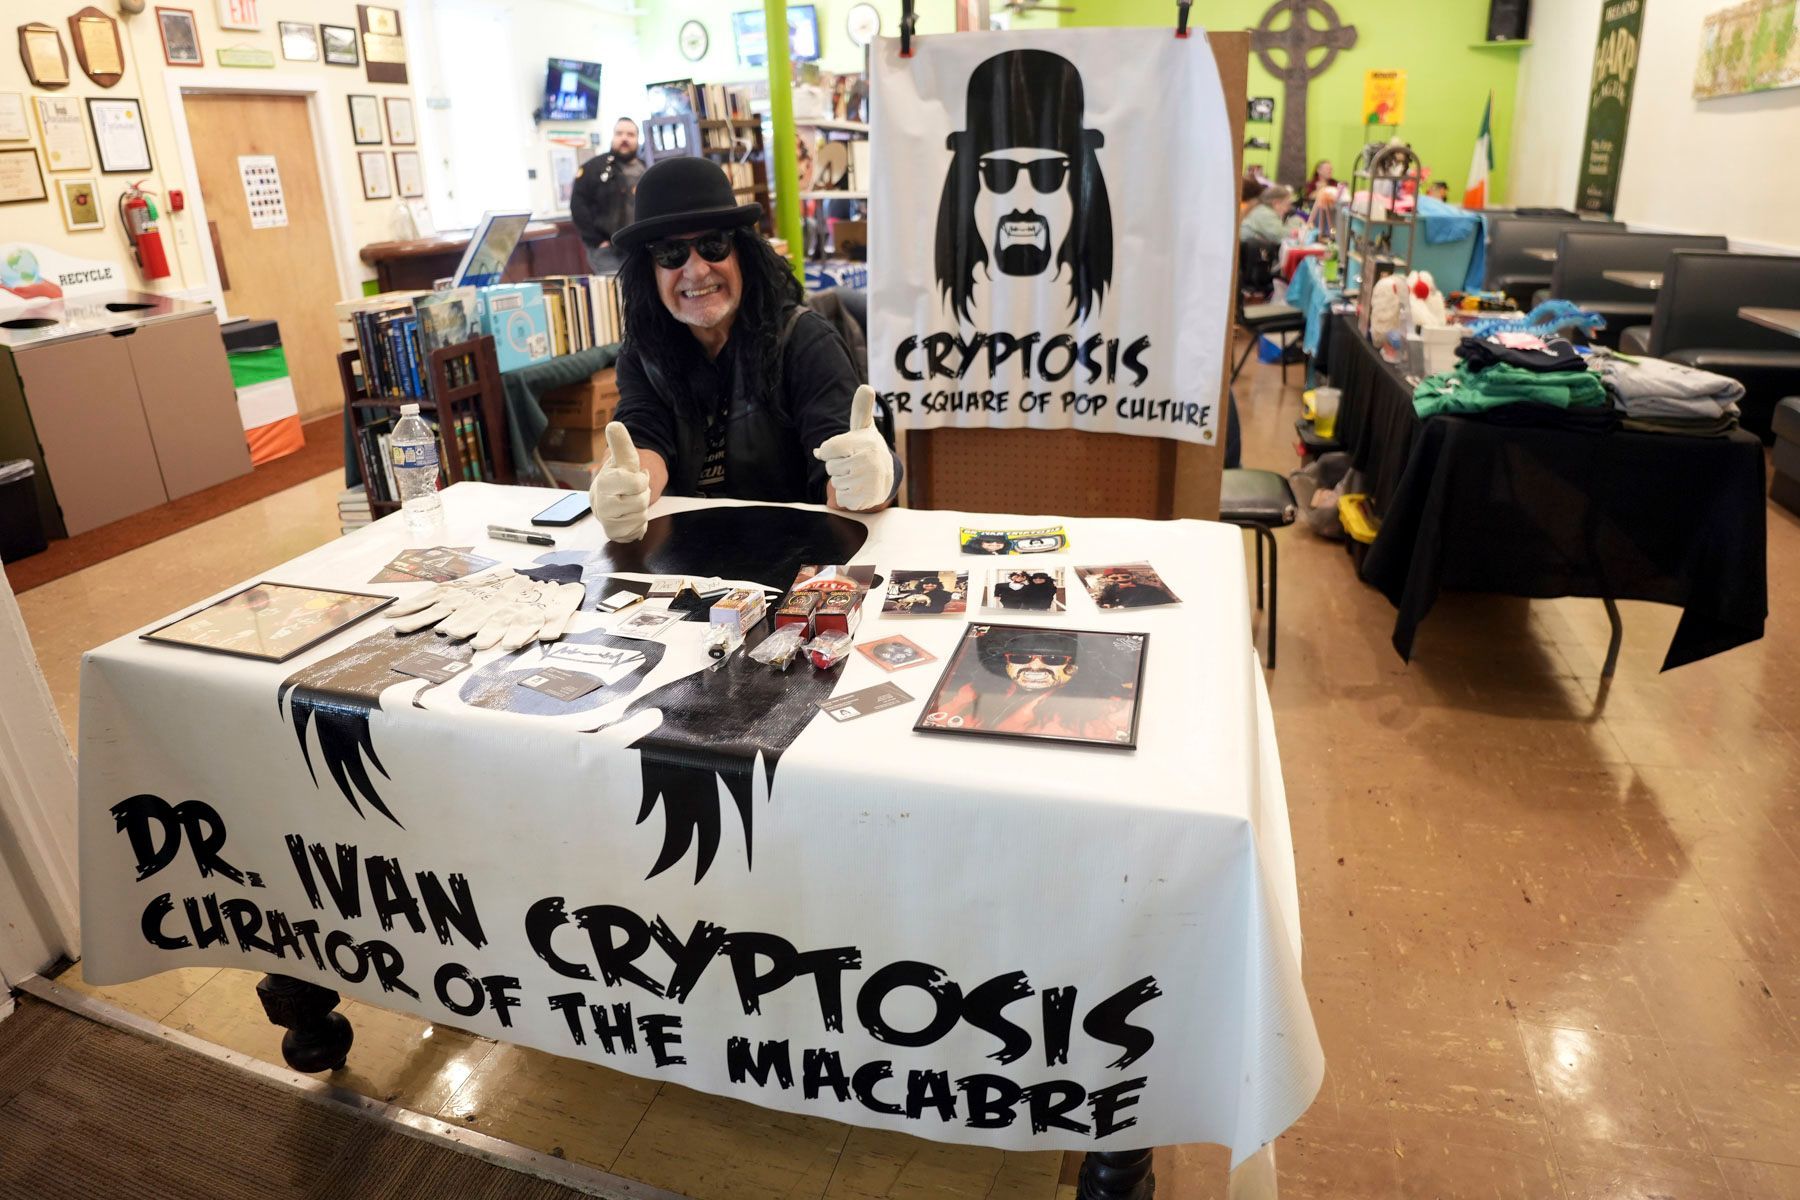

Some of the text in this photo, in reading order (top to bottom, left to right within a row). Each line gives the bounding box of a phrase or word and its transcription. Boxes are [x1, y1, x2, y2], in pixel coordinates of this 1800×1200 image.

[229, 0, 259, 24] EXIT
[1592, 26, 1637, 92] HARP
[59, 267, 113, 287] RECYCLE
[895, 331, 1151, 388] CRYPTOSIS
[920, 390, 1009, 414] SQUARE
[1018, 391, 1052, 413] OF
[1062, 391, 1107, 416] POP
[1116, 396, 1211, 427] CULTURE
[109, 793, 1163, 1071] DR. IVAN CRYPTOSIS
[140, 892, 1149, 1141] CURATOR OF THE MACABRE
